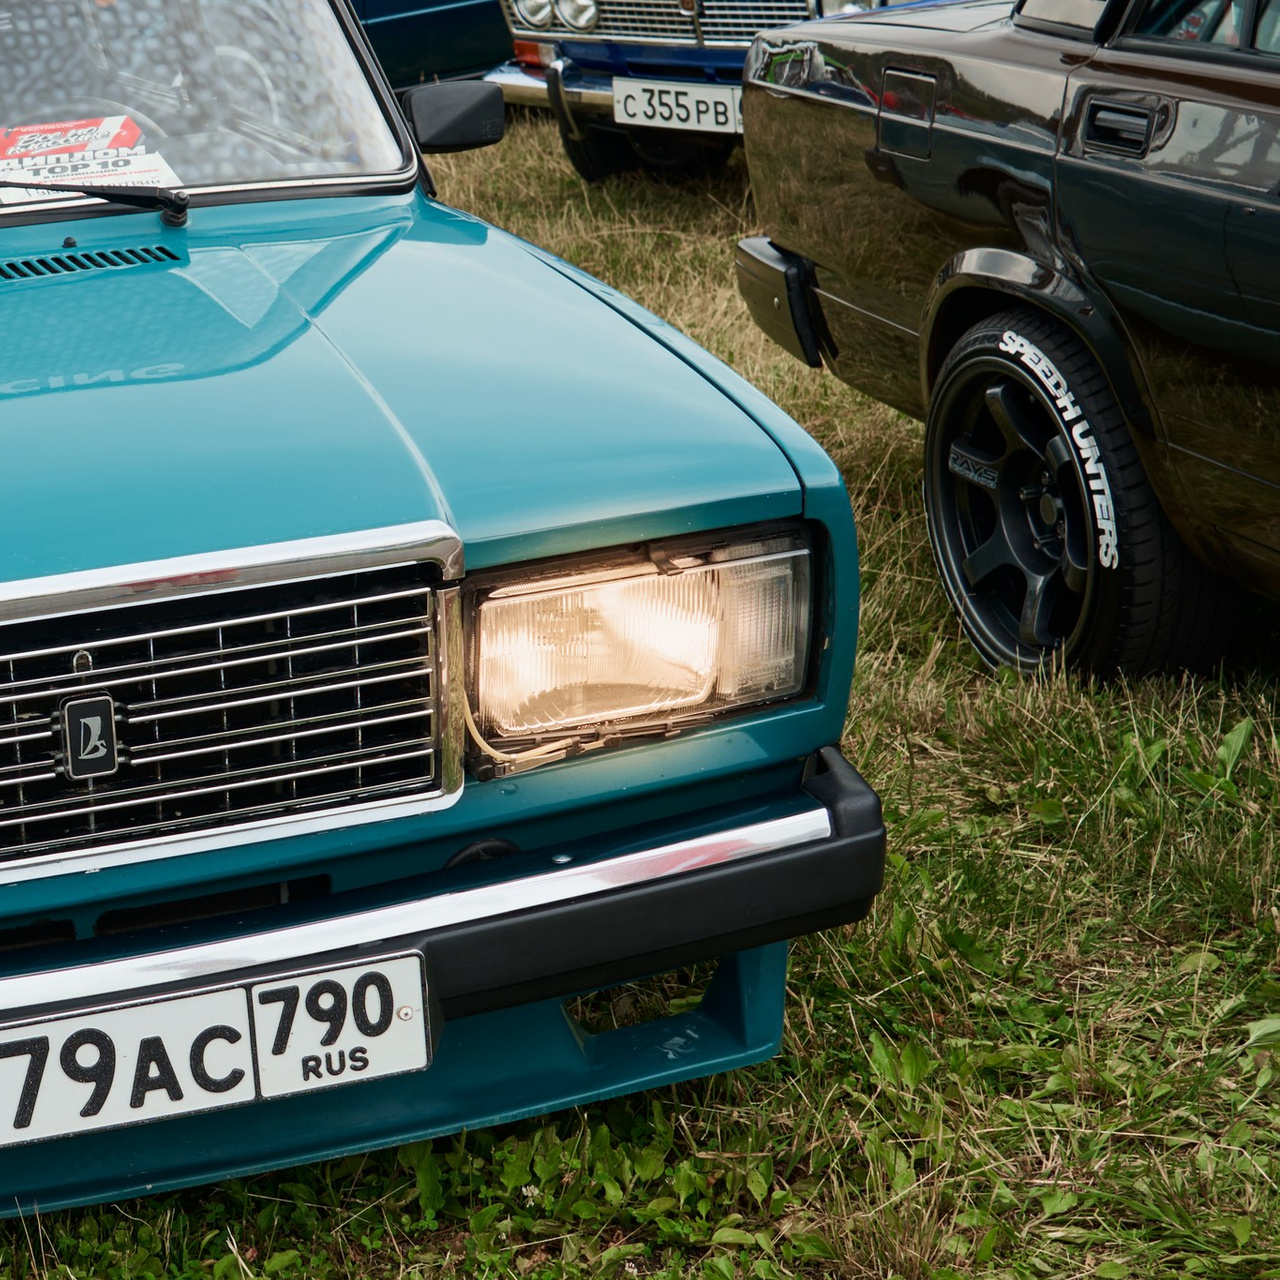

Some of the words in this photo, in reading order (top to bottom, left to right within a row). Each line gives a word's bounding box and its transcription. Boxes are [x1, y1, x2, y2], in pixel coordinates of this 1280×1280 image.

[27, 162, 90, 177] TOP
[96, 159, 131, 170] 10
[998, 329, 1119, 570] SPEEDHUNTERS
[258, 970, 395, 1056] 790
[302, 1046, 370, 1083] RUS
